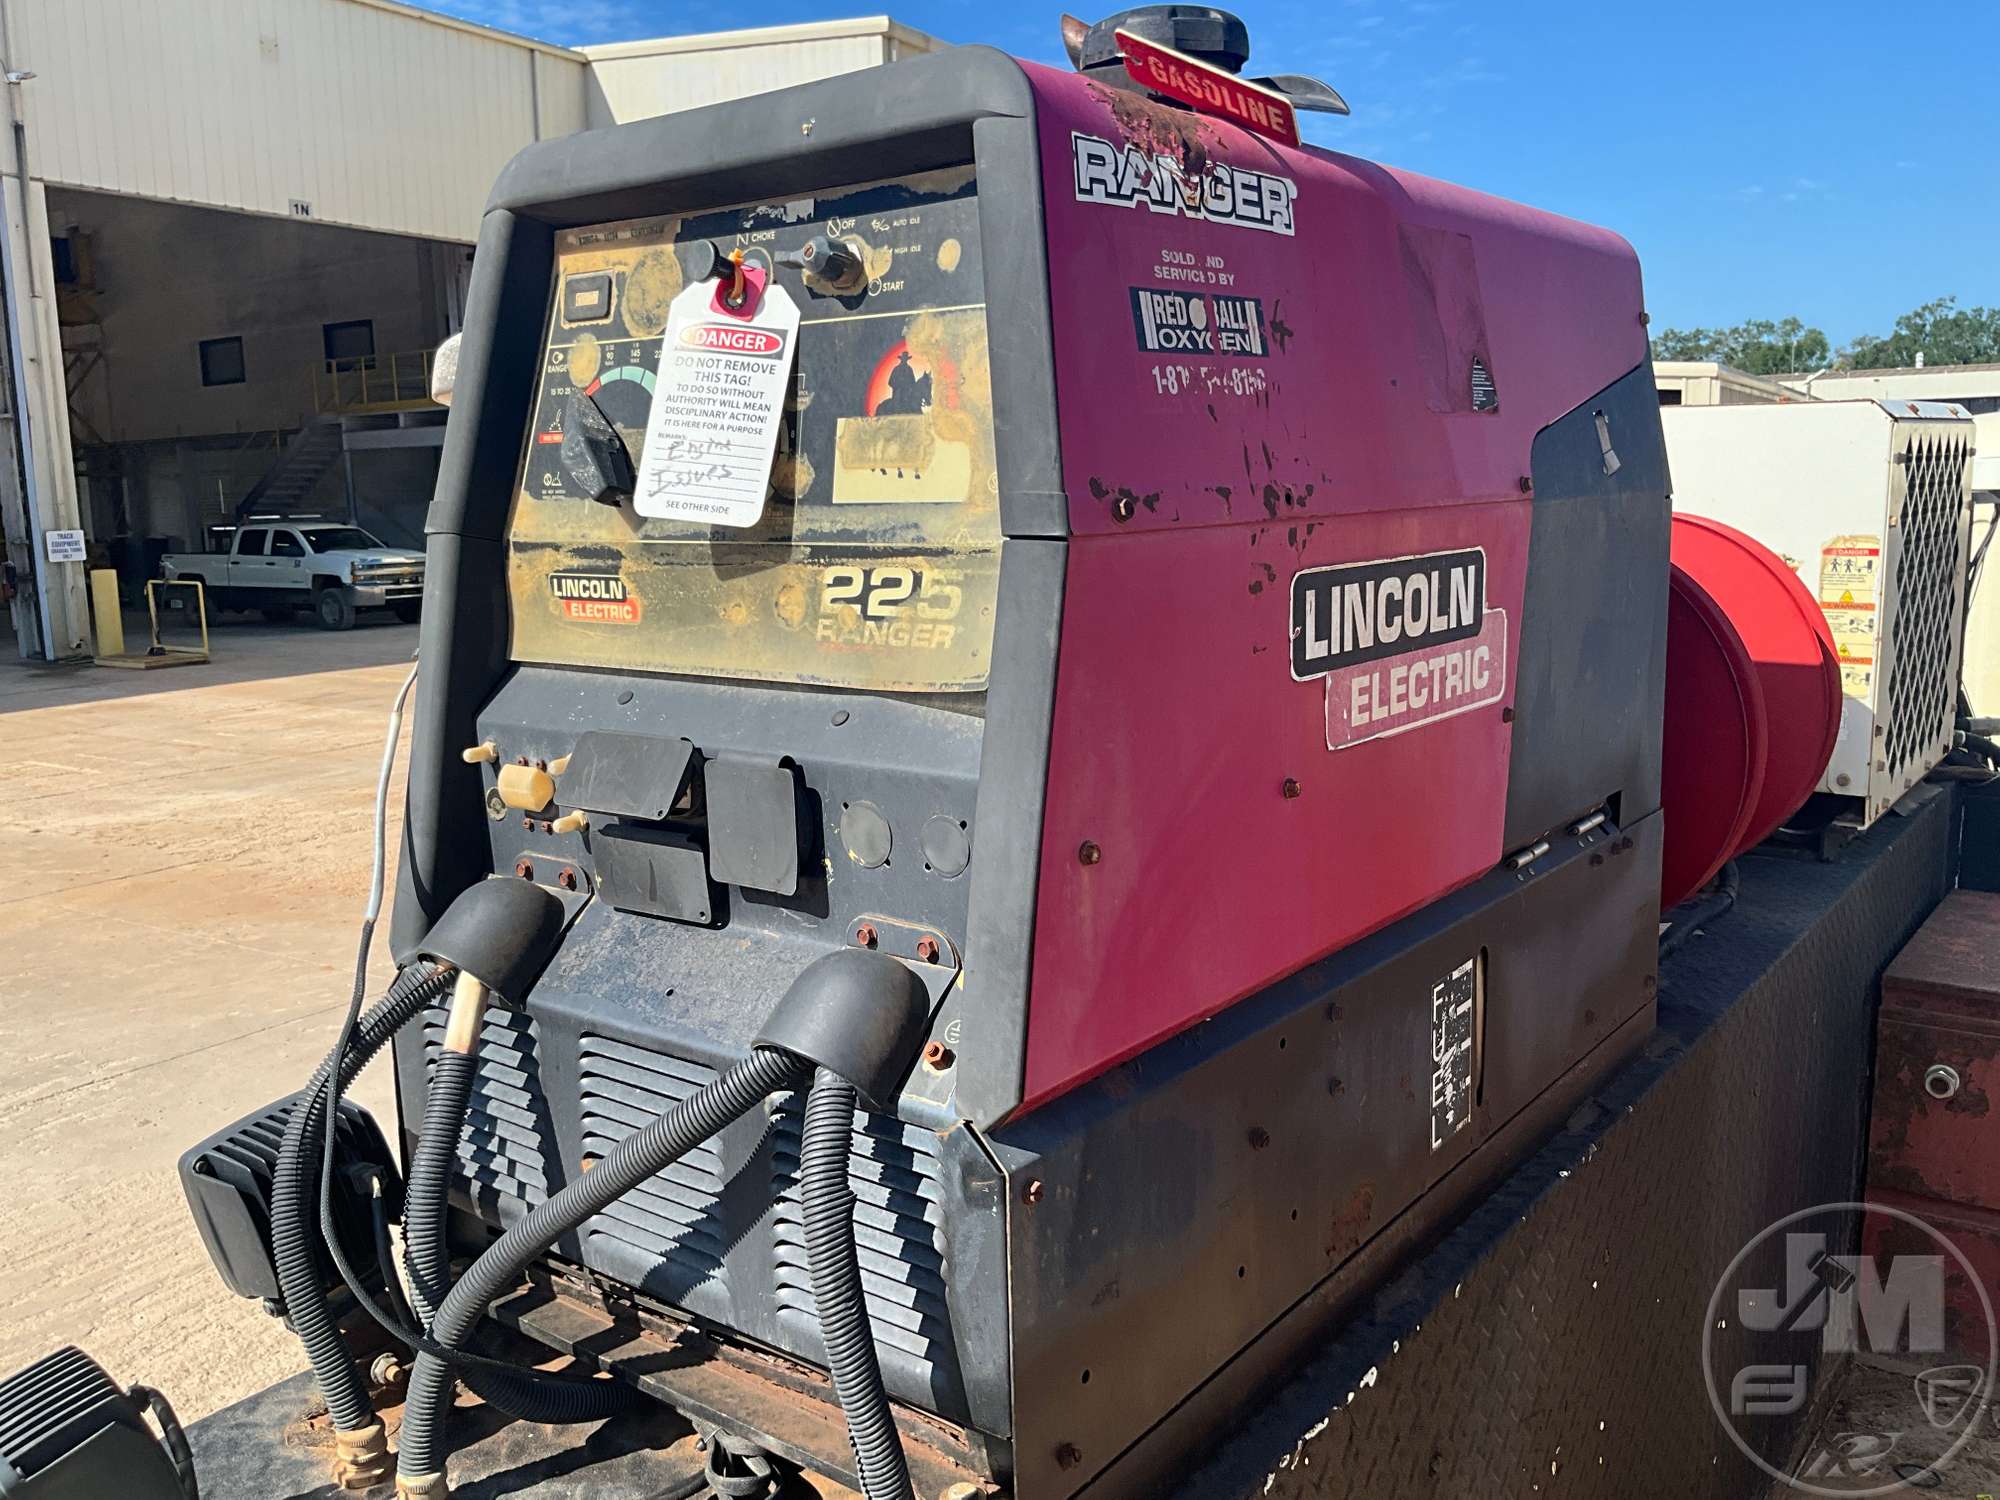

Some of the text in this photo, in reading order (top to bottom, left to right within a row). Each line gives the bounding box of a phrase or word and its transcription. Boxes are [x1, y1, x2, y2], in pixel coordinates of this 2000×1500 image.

[1147, 56, 1288, 134] GASOLINE
[1073, 132, 1296, 236] RANGER
[293, 203, 310, 216] 1N
[842, 219, 856, 230] OFF
[752, 231, 776, 242] CHOKE
[1161, 249, 1195, 265] SOLD
[882, 281, 904, 291] START
[1218, 273, 1235, 287] BY
[1152, 294, 1187, 326] RED
[694, 329, 767, 351] DANGER
[673, 356, 777, 375] DO NOT REMOVE
[694, 372, 752, 386] THIS TAG!
[676, 384, 765, 400] TO DO SO WITHOUT
[665, 394, 772, 412] AUTHORITY WILL MEAN
[665, 406, 768, 424] DISCIPLINARY ACTION!
[681, 421, 701, 429] HERE
[703, 422, 718, 431] FOR
[727, 425, 764, 436] PURPOSE
[665, 500, 731, 515] SEE OTHER SIDE
[553, 578, 624, 600] LINCOLN
[820, 566, 962, 620] 225
[570, 603, 633, 620] ELECTRIC
[1305, 565, 1475, 660] LINCOLN
[1351, 646, 1490, 728] ELECTRIC
